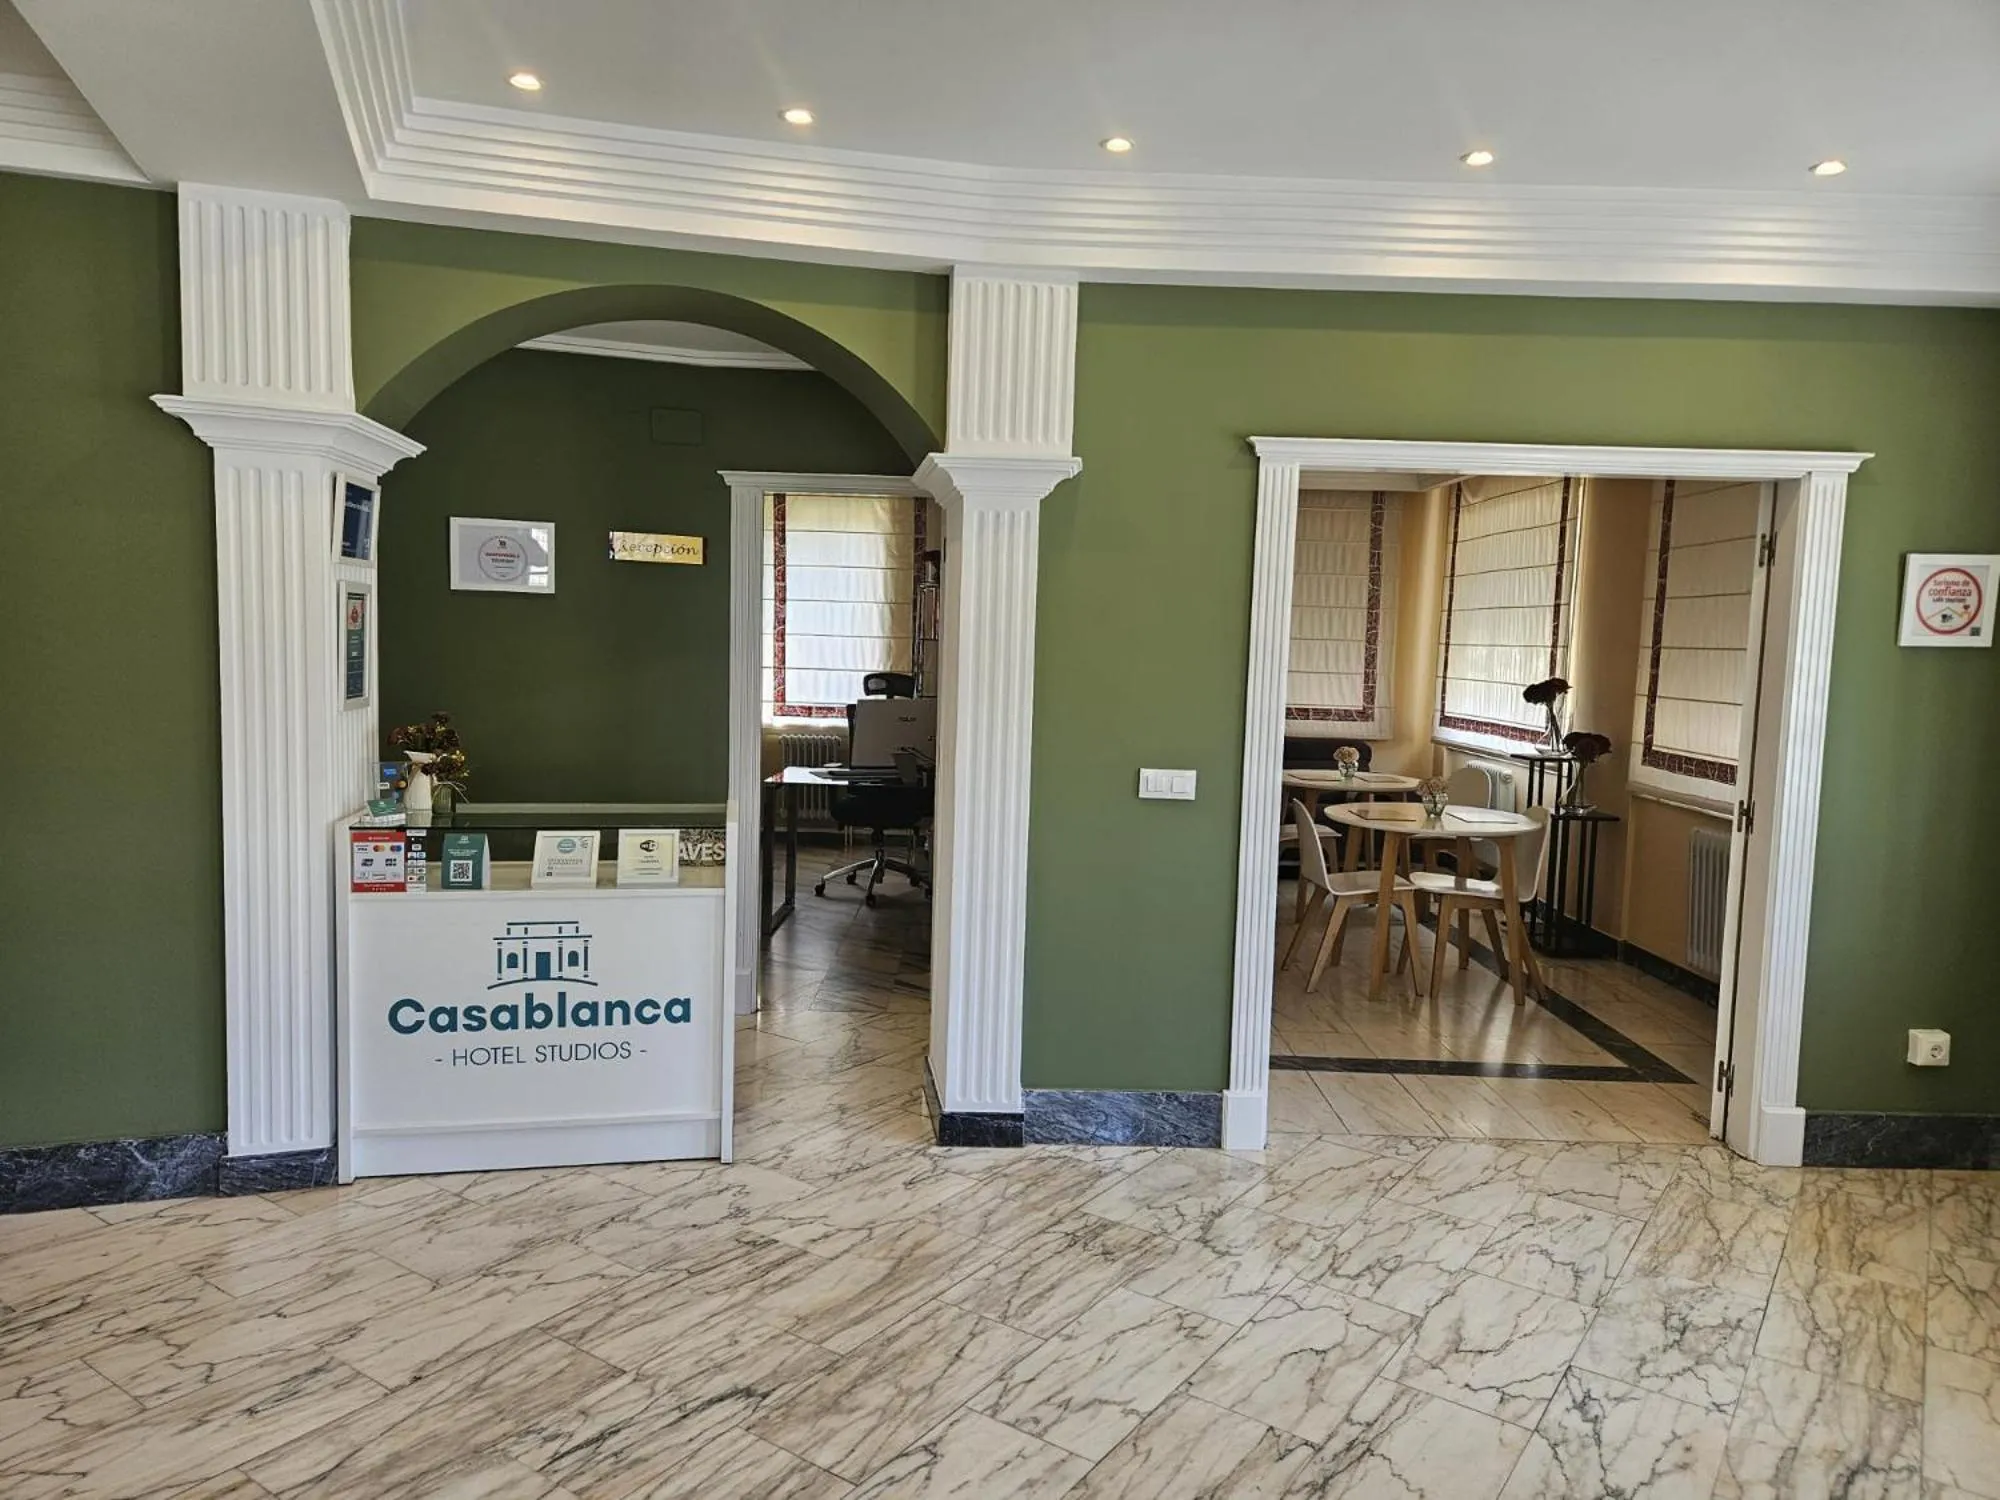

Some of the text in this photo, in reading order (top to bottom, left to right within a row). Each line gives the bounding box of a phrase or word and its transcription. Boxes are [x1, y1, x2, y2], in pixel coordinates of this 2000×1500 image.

[1928, 586, 1972, 597] confianza
[388, 992, 691, 1034] Casablanca
[453, 1046, 526, 1066] HOTEL
[535, 1041, 632, 1063] STUDIOS
